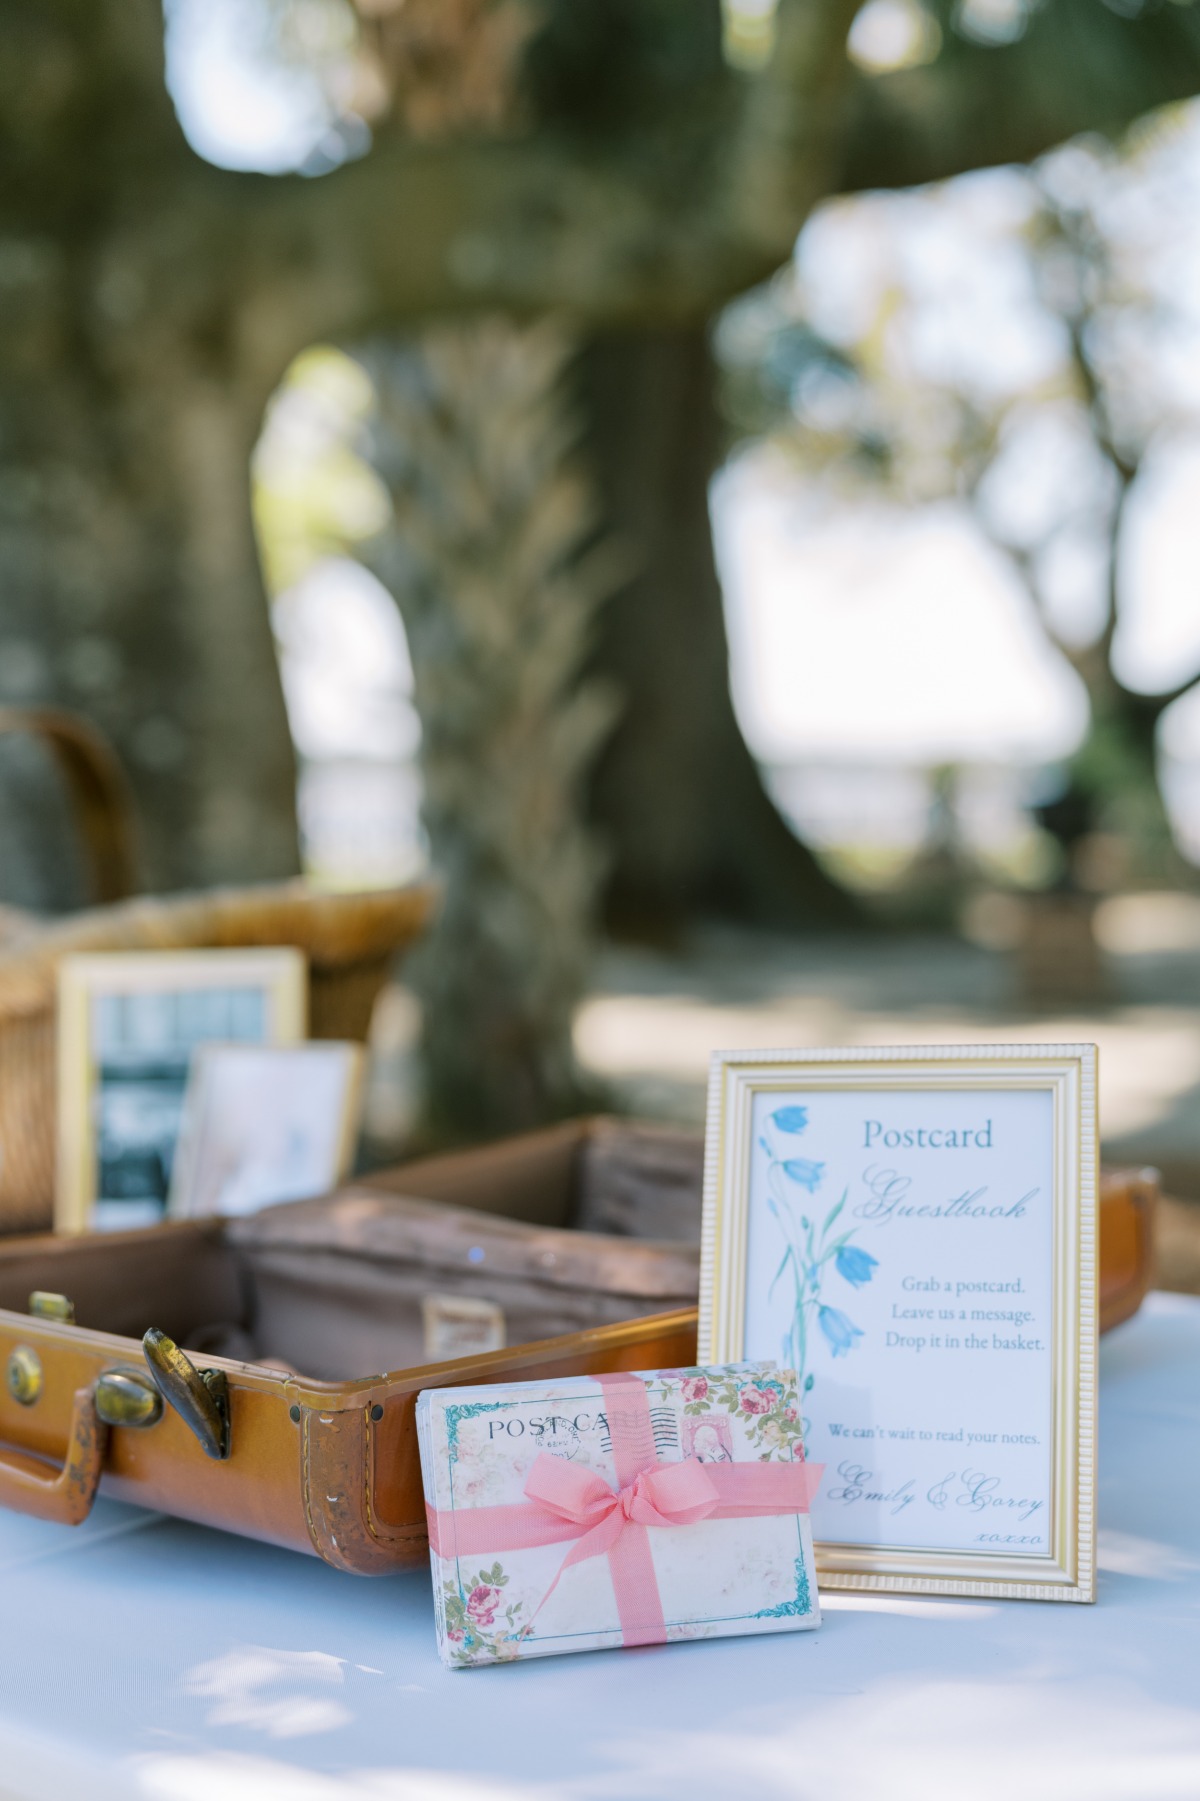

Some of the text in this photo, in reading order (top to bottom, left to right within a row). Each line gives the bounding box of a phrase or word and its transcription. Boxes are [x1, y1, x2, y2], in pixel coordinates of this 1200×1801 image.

[862, 1118, 994, 1149] Postcard
[851, 1163, 1041, 1227] Guestbook
[901, 1275, 1026, 1298] Grab a postcard.
[891, 1303, 1036, 1327] Leave us a message.
[885, 1330, 1046, 1353] Drop it in the basket.
[488, 1415, 562, 1440] POST
[827, 1423, 1041, 1447] We can't wait to read your notes.
[826, 1459, 1045, 1522] Emily & Corey
